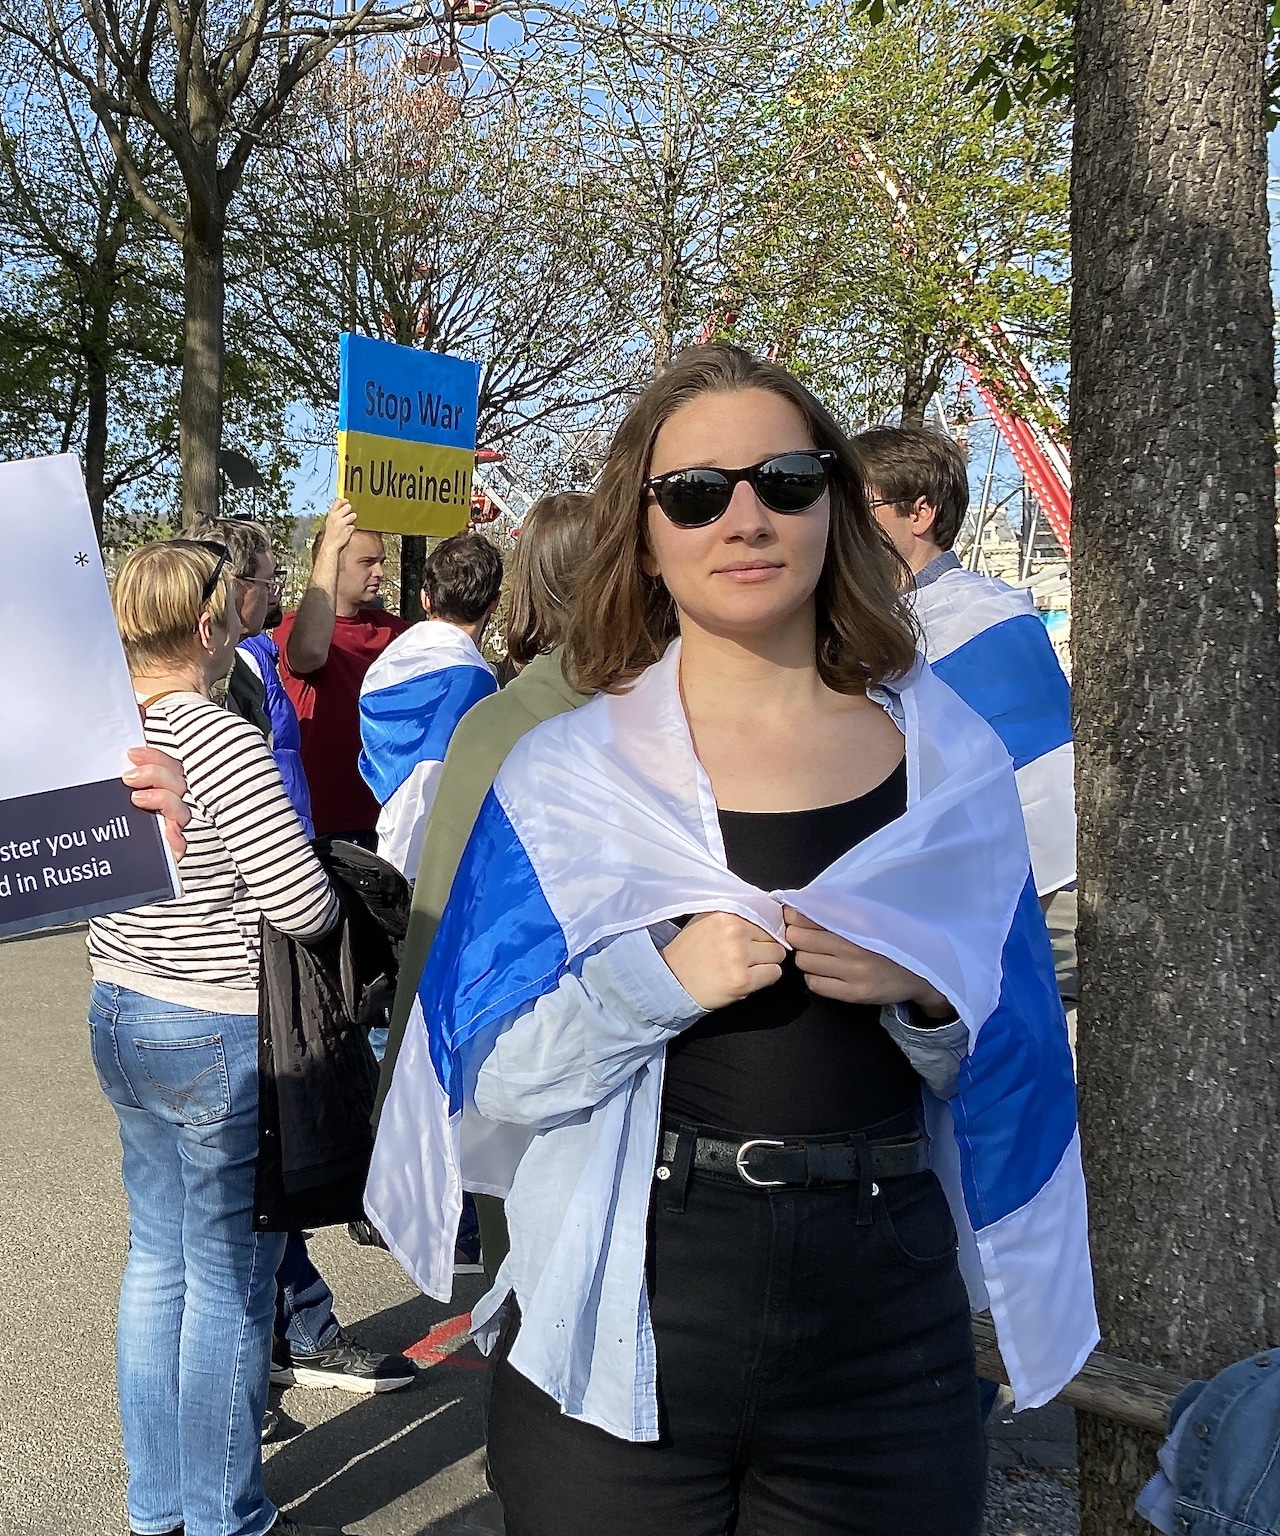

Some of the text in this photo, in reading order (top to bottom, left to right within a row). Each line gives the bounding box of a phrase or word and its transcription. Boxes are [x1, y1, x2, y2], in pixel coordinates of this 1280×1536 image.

[365, 380, 464, 430] Stop War
[344, 455, 362, 493] in
[45, 830, 88, 856] you
[90, 815, 130, 842] will
[15, 872, 38, 893] in
[42, 857, 112, 888] Russia
